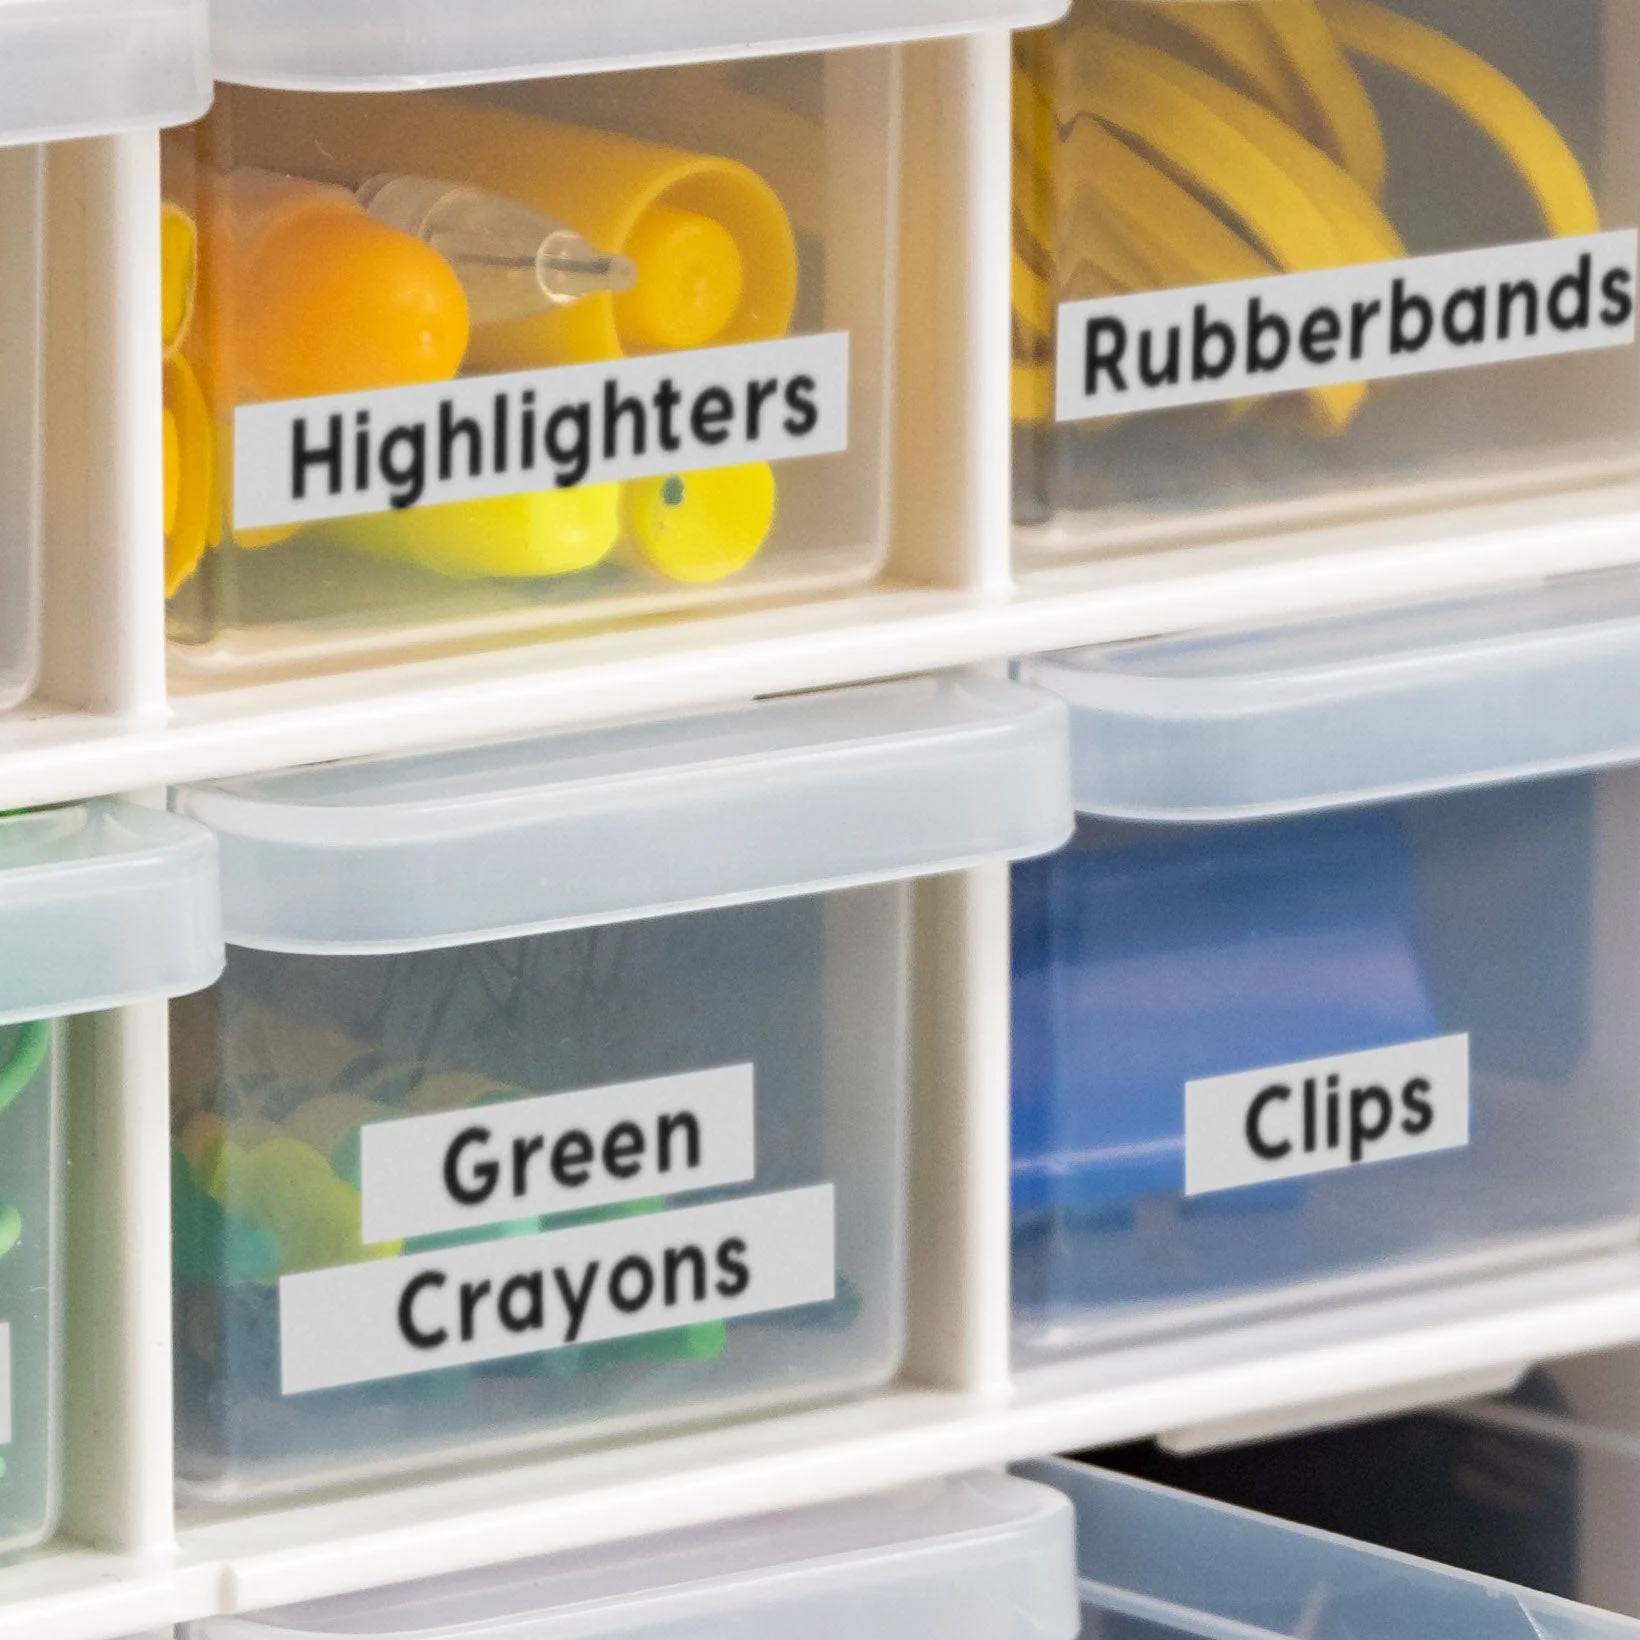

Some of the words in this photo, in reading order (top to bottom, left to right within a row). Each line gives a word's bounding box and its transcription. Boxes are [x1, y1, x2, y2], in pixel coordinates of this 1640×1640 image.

[1084, 252, 1633, 396] Rubberbands
[291, 374, 818, 512] Highlighters
[442, 1110, 701, 1206] Green
[1244, 1074, 1434, 1163] Clips
[397, 1237, 750, 1350] Crayons
